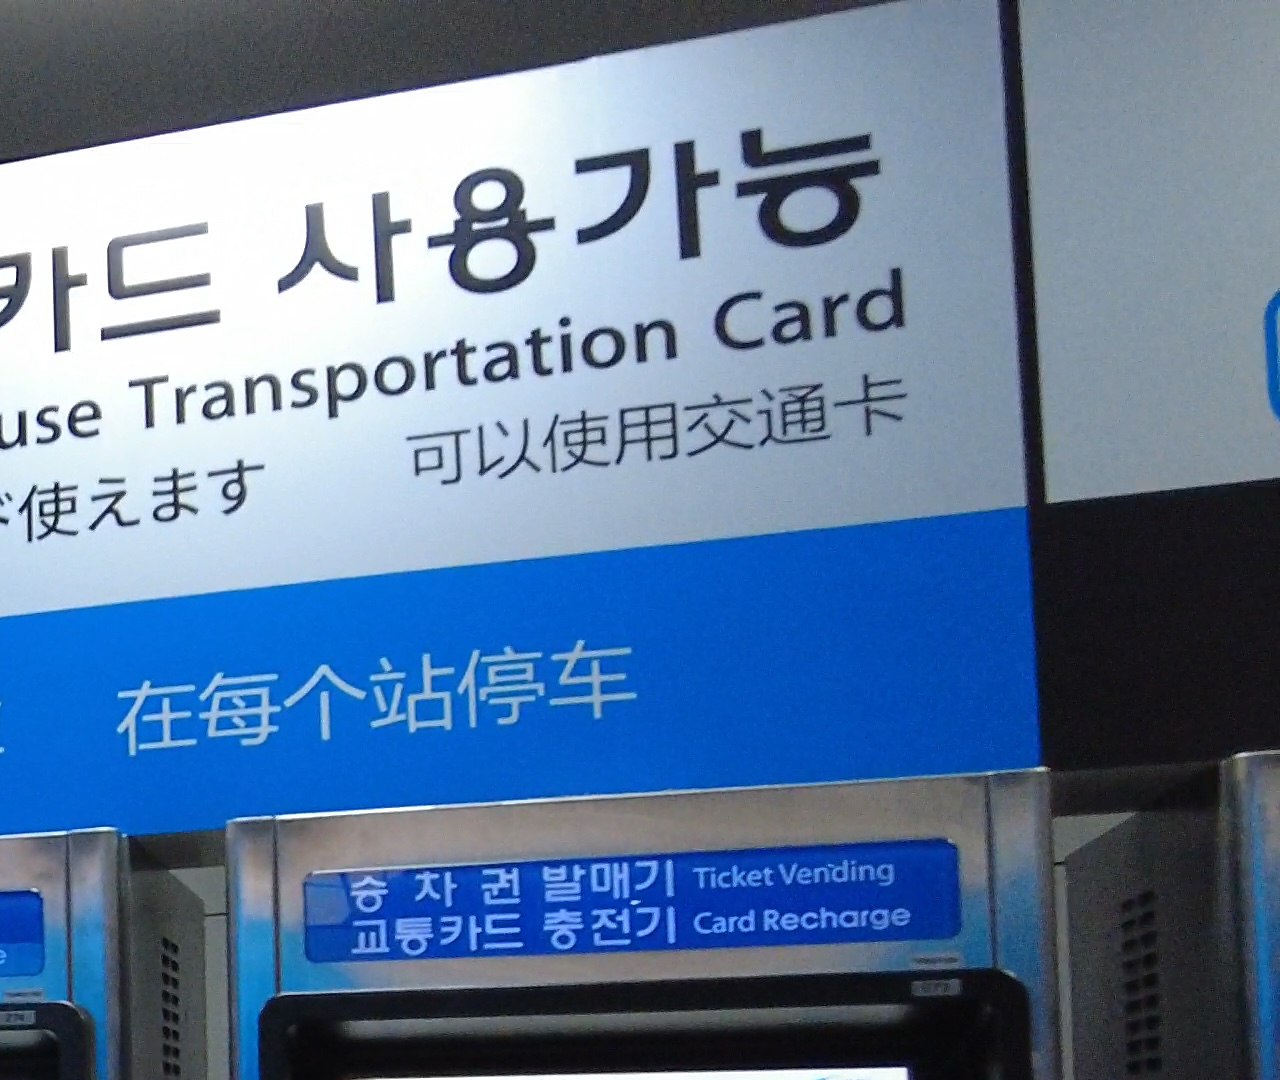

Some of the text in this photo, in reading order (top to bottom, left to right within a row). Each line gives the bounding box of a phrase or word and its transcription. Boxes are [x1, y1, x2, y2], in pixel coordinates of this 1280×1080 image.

[277, 128, 880, 304] 사용가능
[128, 315, 677, 430] Transportation
[715, 267, 906, 350] Card
[406, 373, 908, 485] 可以使用交通卡
[117, 639, 637, 755] 在每个站停车
[542, 859, 675, 902] 발매기
[692, 859, 895, 889] Ticket Vending
[351, 906, 676, 956] 교통카드 충전기
[693, 906, 912, 934] Card Recharge
